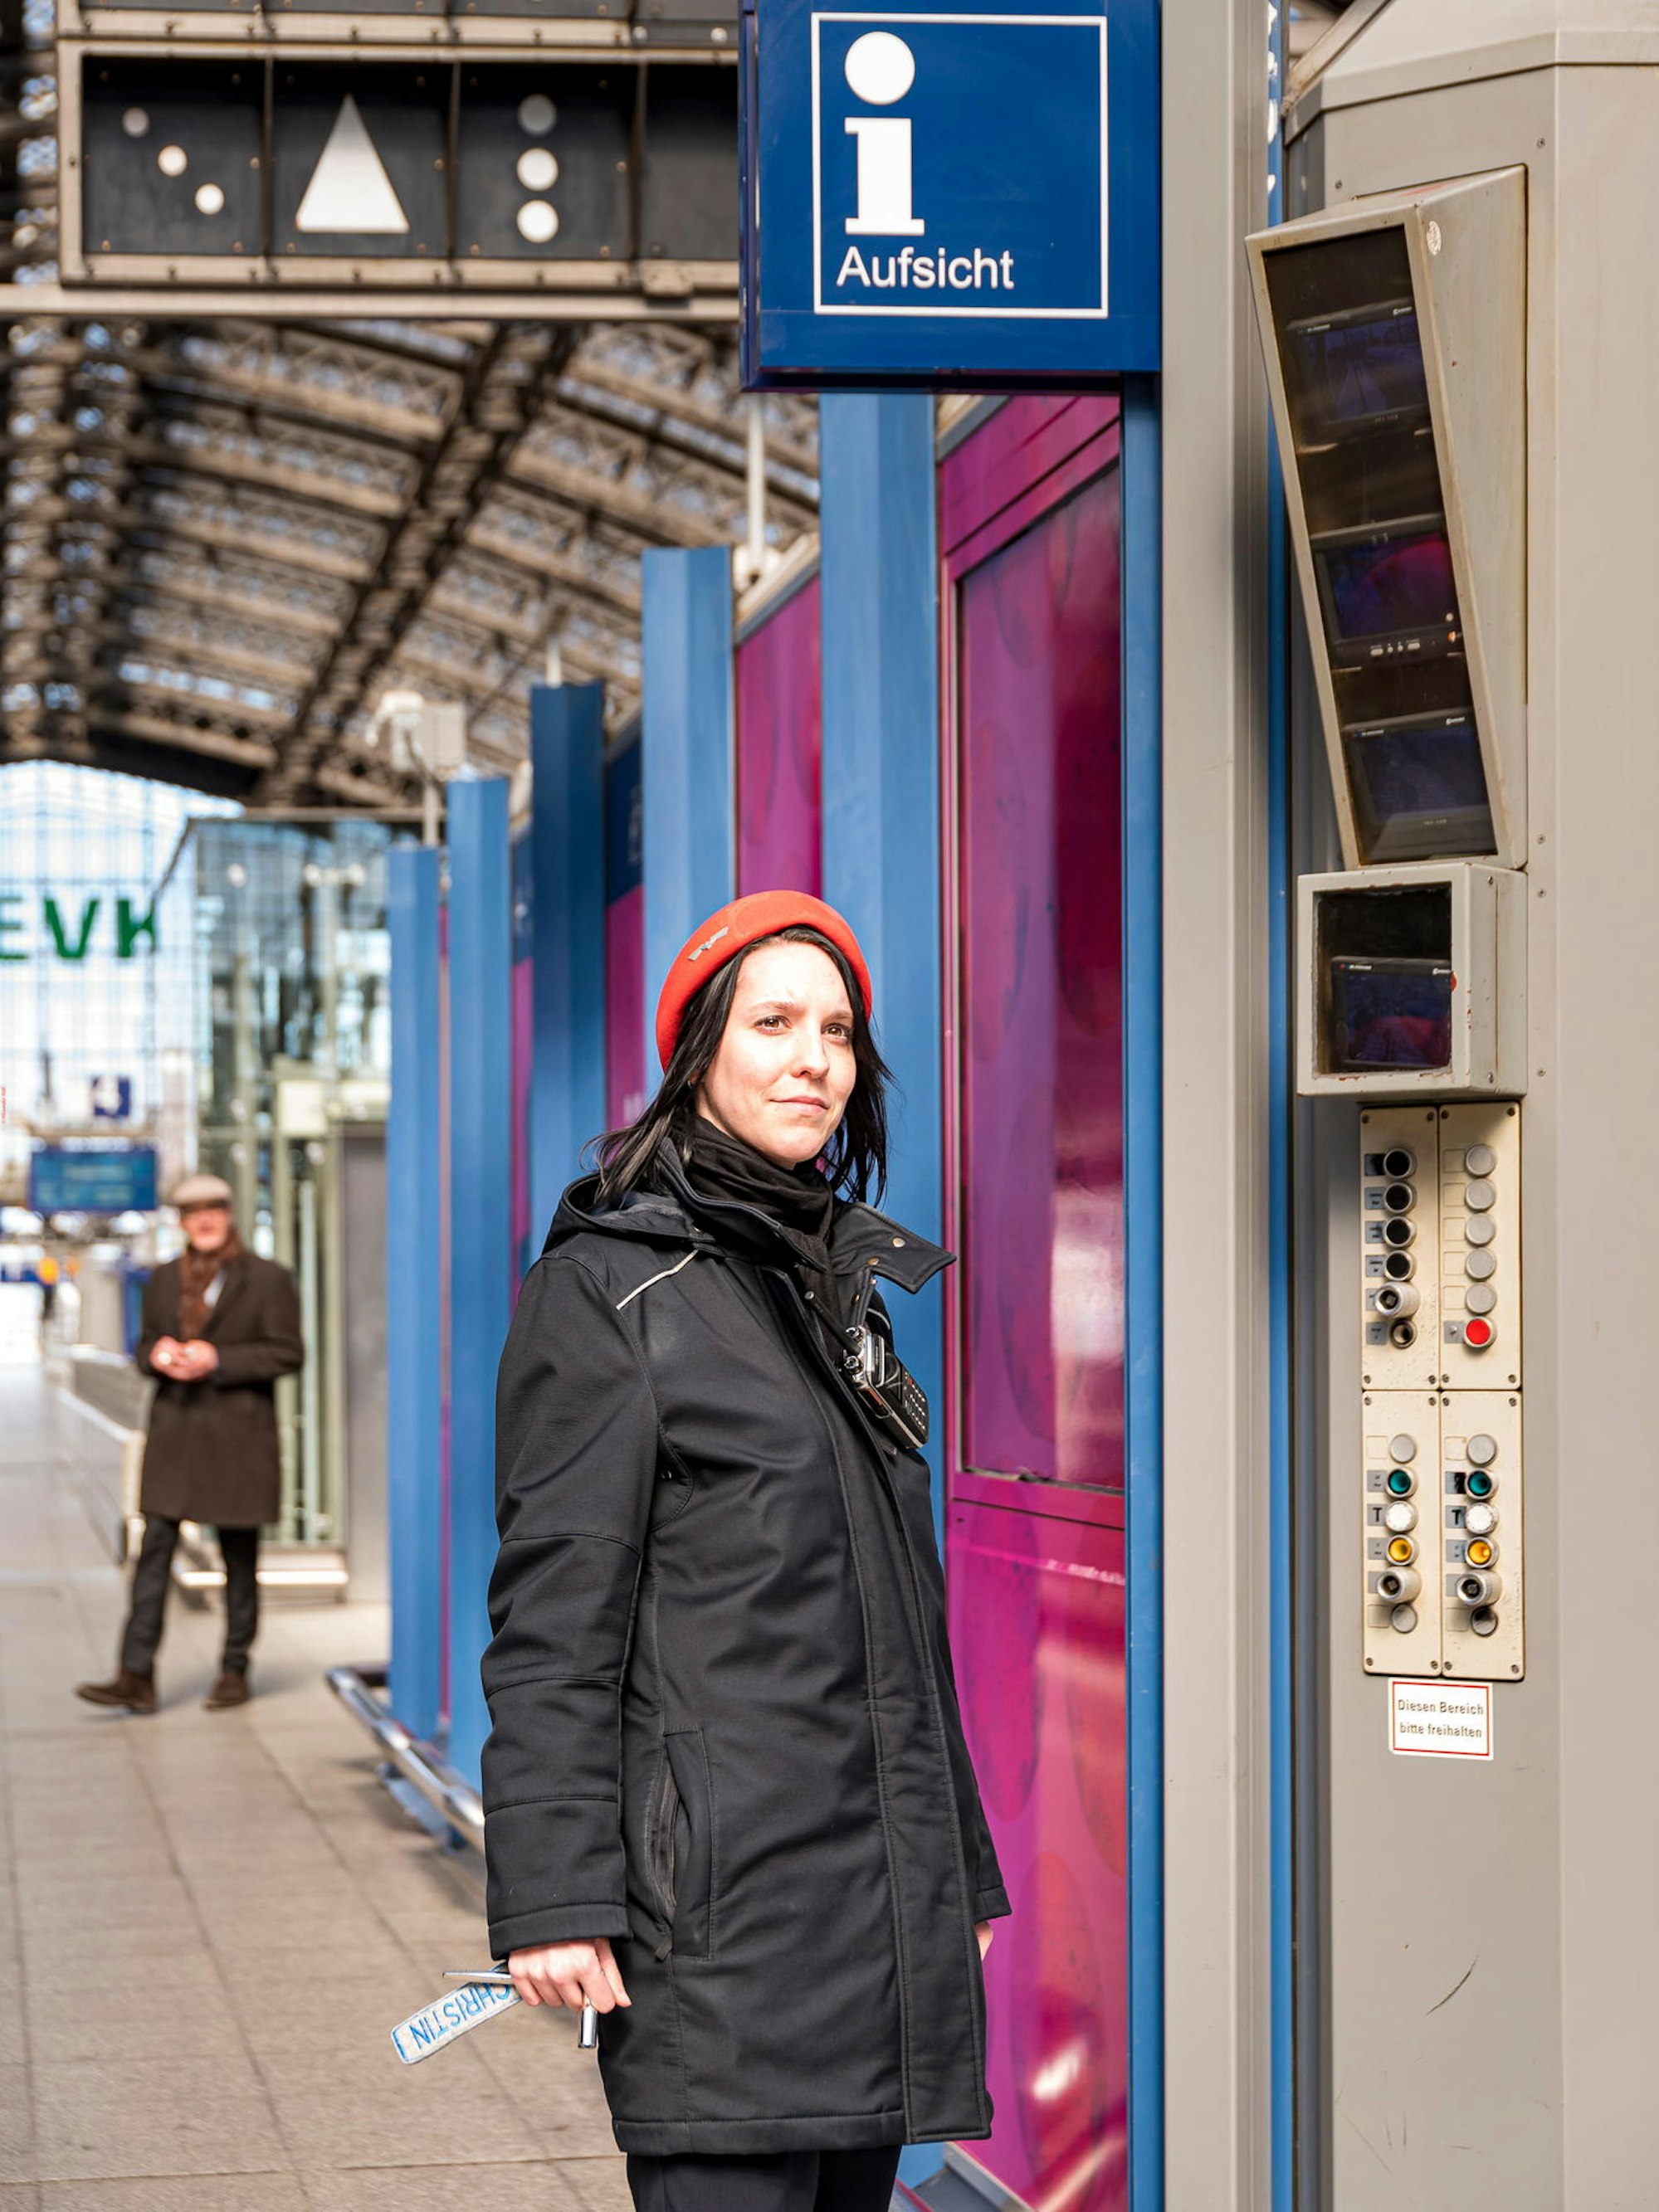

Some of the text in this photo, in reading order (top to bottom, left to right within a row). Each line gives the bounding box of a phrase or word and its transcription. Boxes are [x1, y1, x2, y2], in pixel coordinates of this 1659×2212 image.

[836, 246, 1015, 290] Aufsicht
[1372, 1507, 1383, 1523] T
[1451, 1508, 1461, 1525] T
[1398, 1698, 1484, 1715] Diesen Bereich
[1399, 1722, 1482, 1738] bitte freihalten
[408, 1984, 510, 2049] CHRISTIN
